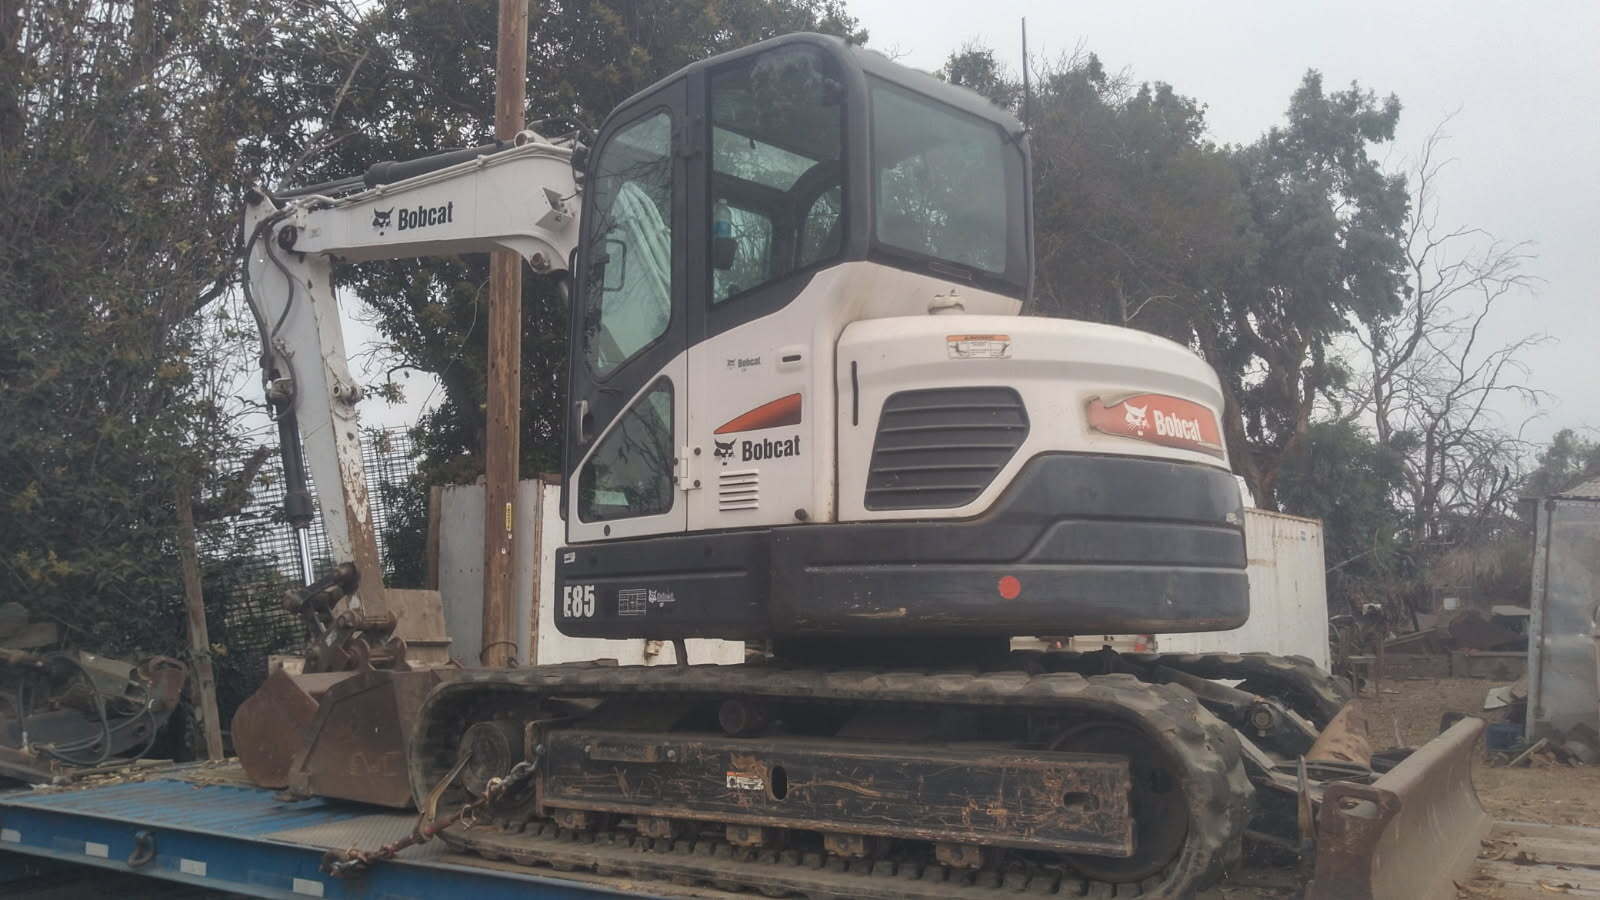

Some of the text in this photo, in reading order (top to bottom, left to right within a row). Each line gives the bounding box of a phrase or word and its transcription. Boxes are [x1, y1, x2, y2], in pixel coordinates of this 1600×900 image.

[398, 201, 454, 231] Bobcat
[737, 356, 761, 368] Bobcat
[1152, 409, 1202, 441] Bobcat
[741, 434, 801, 462] Bobcat
[563, 584, 596, 618] E85
